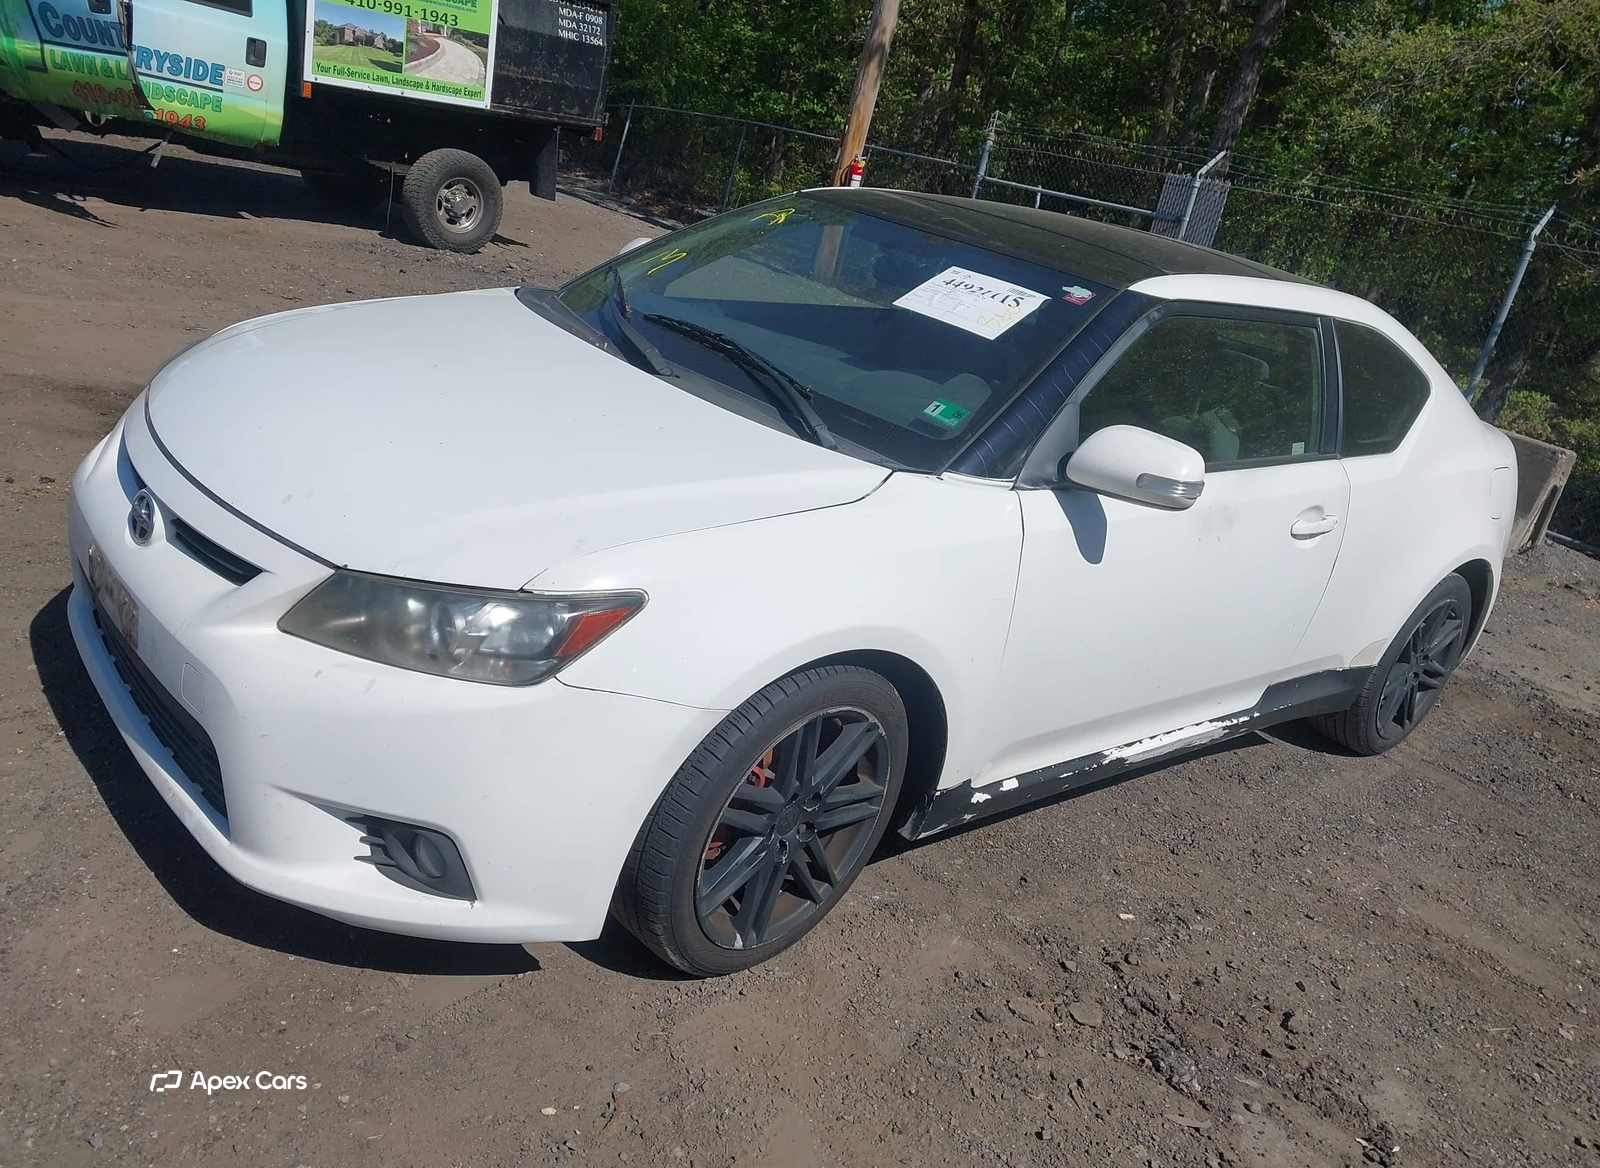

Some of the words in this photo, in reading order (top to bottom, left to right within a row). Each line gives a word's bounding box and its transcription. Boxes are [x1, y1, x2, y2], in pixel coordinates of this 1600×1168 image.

[558, 6, 584, 20] MDA-F
[585, 13, 603, 25] 0908
[558, 18, 578, 30] MDA
[579, 22, 601, 36] 32172
[558, 29, 580, 42] MHIC
[582, 34, 603, 47] 13564
[49, 49, 98, 76] LAWN
[100, 57, 114, 78] &
[316, 62, 332, 73] Your
[333, 65, 371, 80] Full-Service
[372, 72, 390, 85] Lawn,
[391, 75, 424, 91] Landscape
[425, 80, 430, 90] &
[431, 81, 463, 96] Hardscape
[463, 87, 482, 99] Expert
